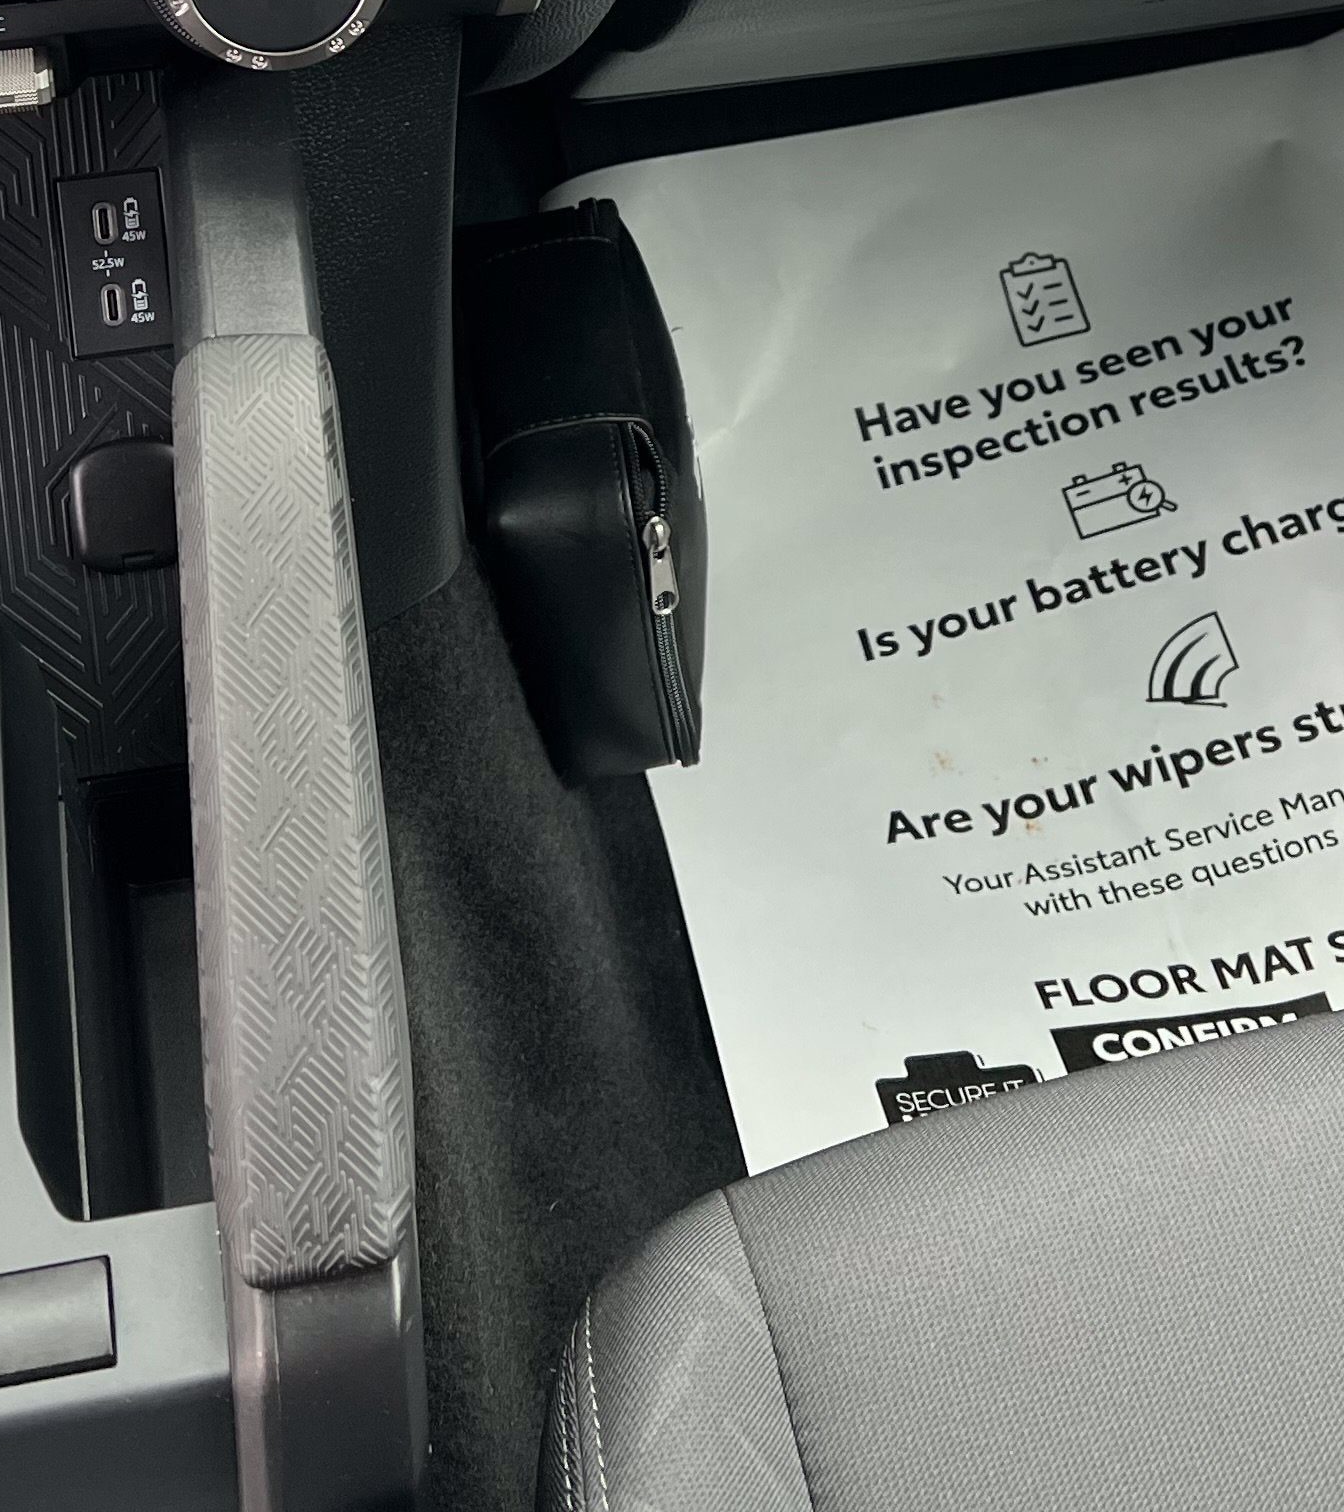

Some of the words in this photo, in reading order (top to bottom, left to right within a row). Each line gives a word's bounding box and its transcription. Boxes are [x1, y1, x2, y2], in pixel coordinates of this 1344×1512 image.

[122, 230, 147, 242] 45W
[131, 311, 155, 323] 45W
[855, 393, 971, 441] Have
[978, 367, 1066, 420] you
[1076, 335, 1184, 385] seen
[1189, 296, 1294, 356] your
[873, 401, 1121, 490] inspection
[1130, 335, 1307, 417] results?
[857, 628, 900, 662] Is
[907, 592, 1017, 658] your
[1026, 539, 1209, 613] battery
[885, 809, 973, 844] Are
[982, 773, 1098, 836] your
[1107, 723, 1283, 793] wipers
[943, 867, 1014, 897] Your
[1024, 835, 1162, 885] Assistant
[1164, 803, 1275, 852] Service
[1023, 886, 1093, 919] with
[1100, 871, 1184, 910] these
[1191, 829, 1340, 887] questions
[1034, 964, 1207, 1011] FLOOR
[1211, 935, 1317, 990] MAT
